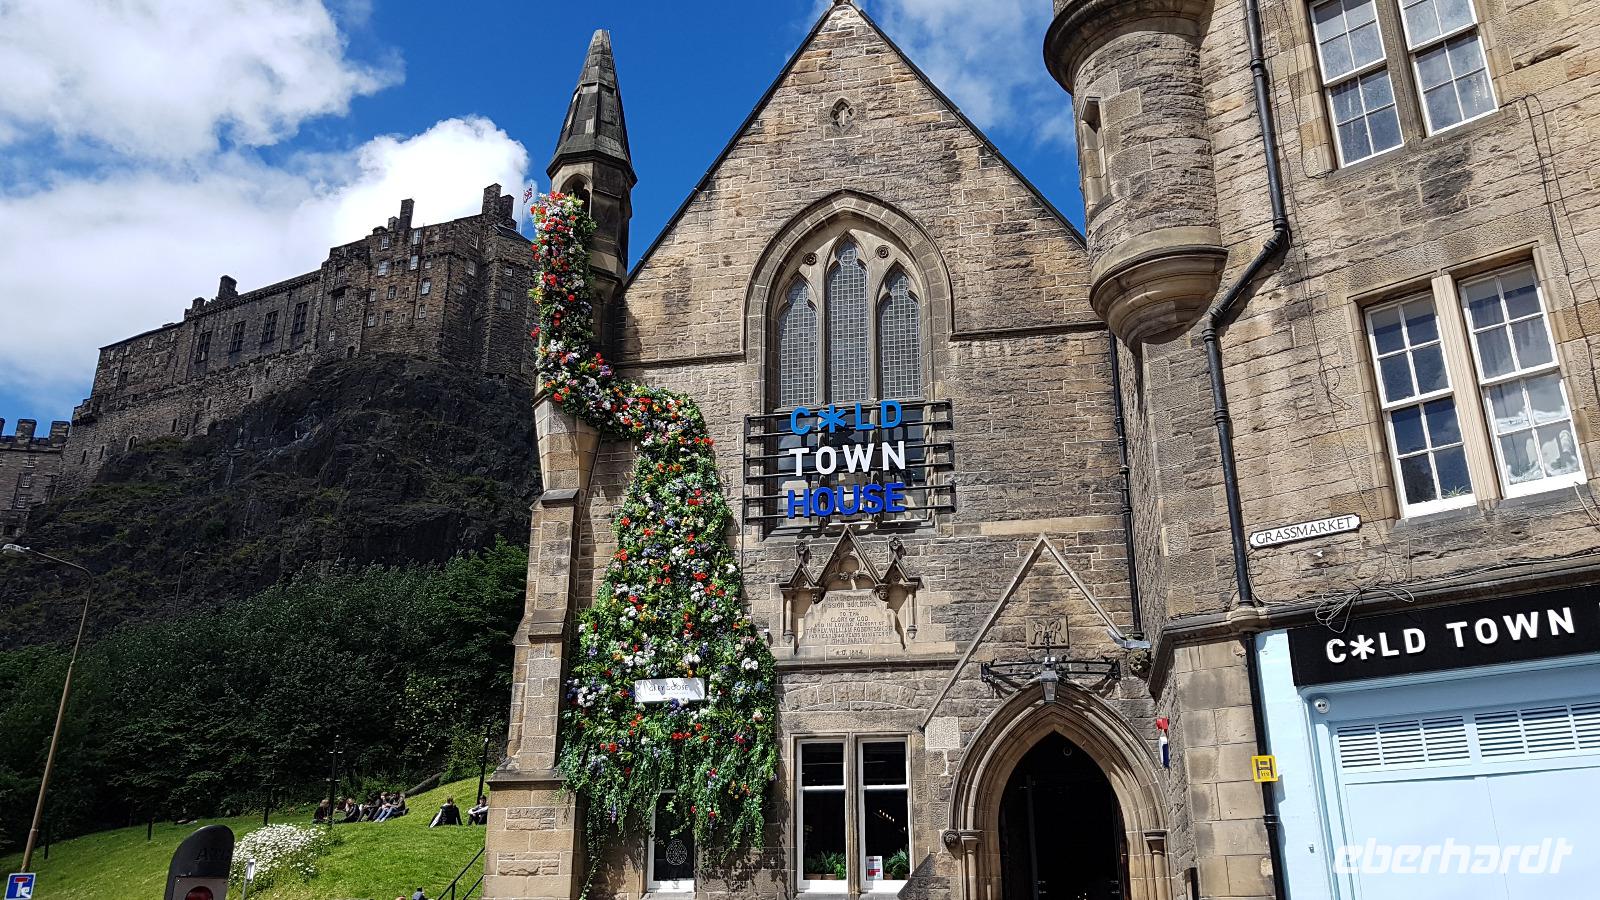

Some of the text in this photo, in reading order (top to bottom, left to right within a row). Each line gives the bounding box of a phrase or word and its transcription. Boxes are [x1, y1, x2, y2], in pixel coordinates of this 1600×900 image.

[788, 441, 906, 477] TOWN
[787, 482, 907, 519] HOUSE
[1254, 516, 1354, 545] GRASSMARKET
[1446, 606, 1577, 649] TOWN
